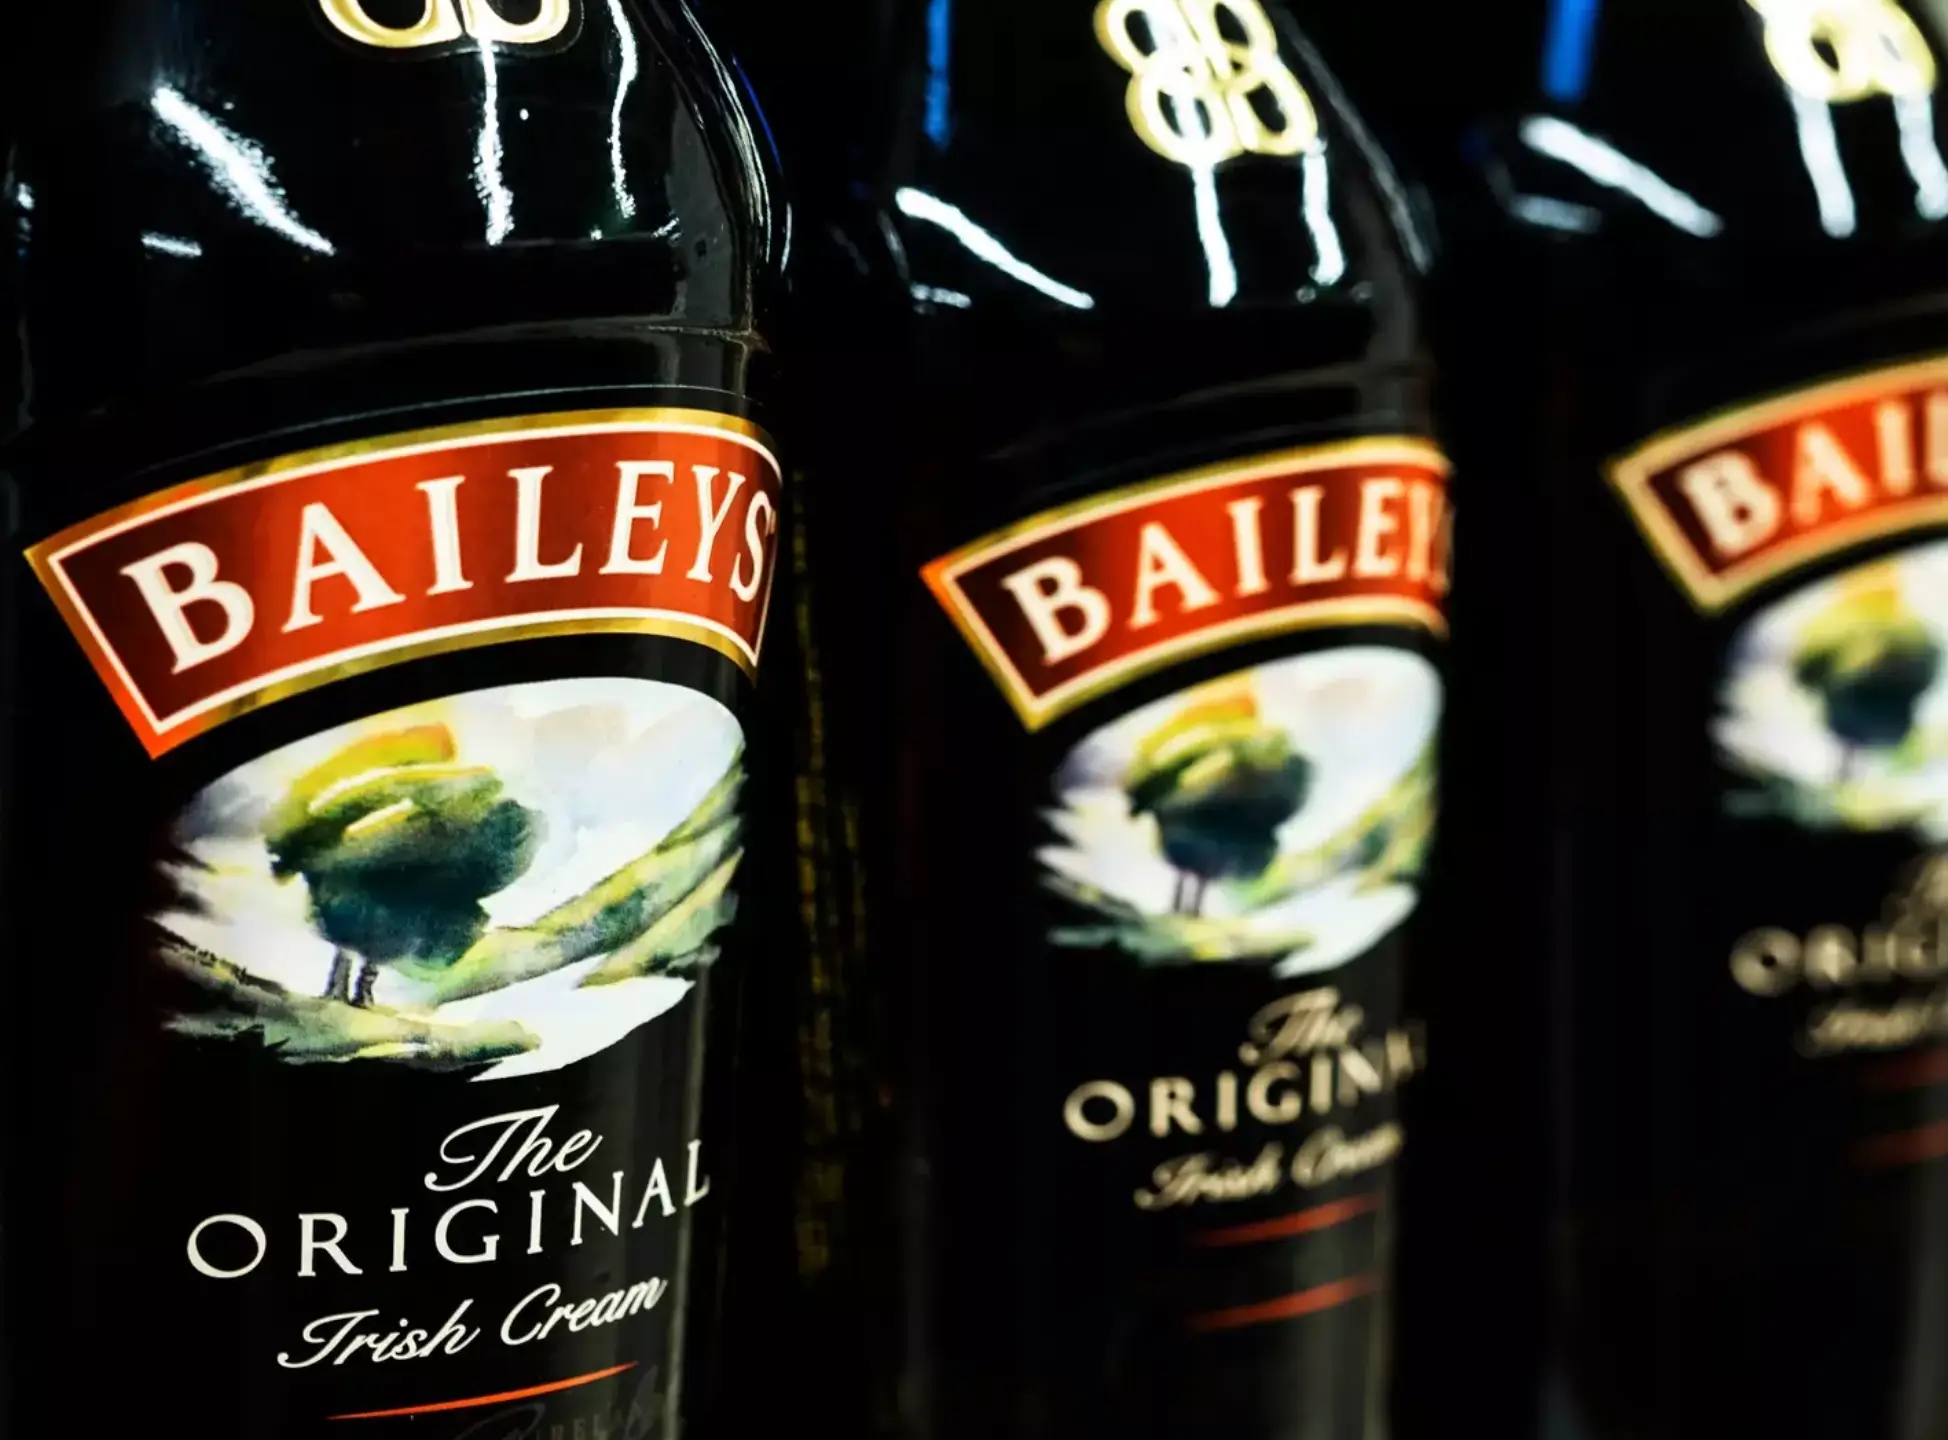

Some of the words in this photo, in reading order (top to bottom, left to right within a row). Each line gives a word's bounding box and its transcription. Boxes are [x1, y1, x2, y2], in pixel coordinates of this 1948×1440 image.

[120, 459, 770, 676] BAILEYS
[423, 1103, 604, 1193] The
[186, 1138, 710, 1279] ORIGINAL
[276, 1298, 481, 1370] Irish
[500, 1275, 669, 1346] Cream
